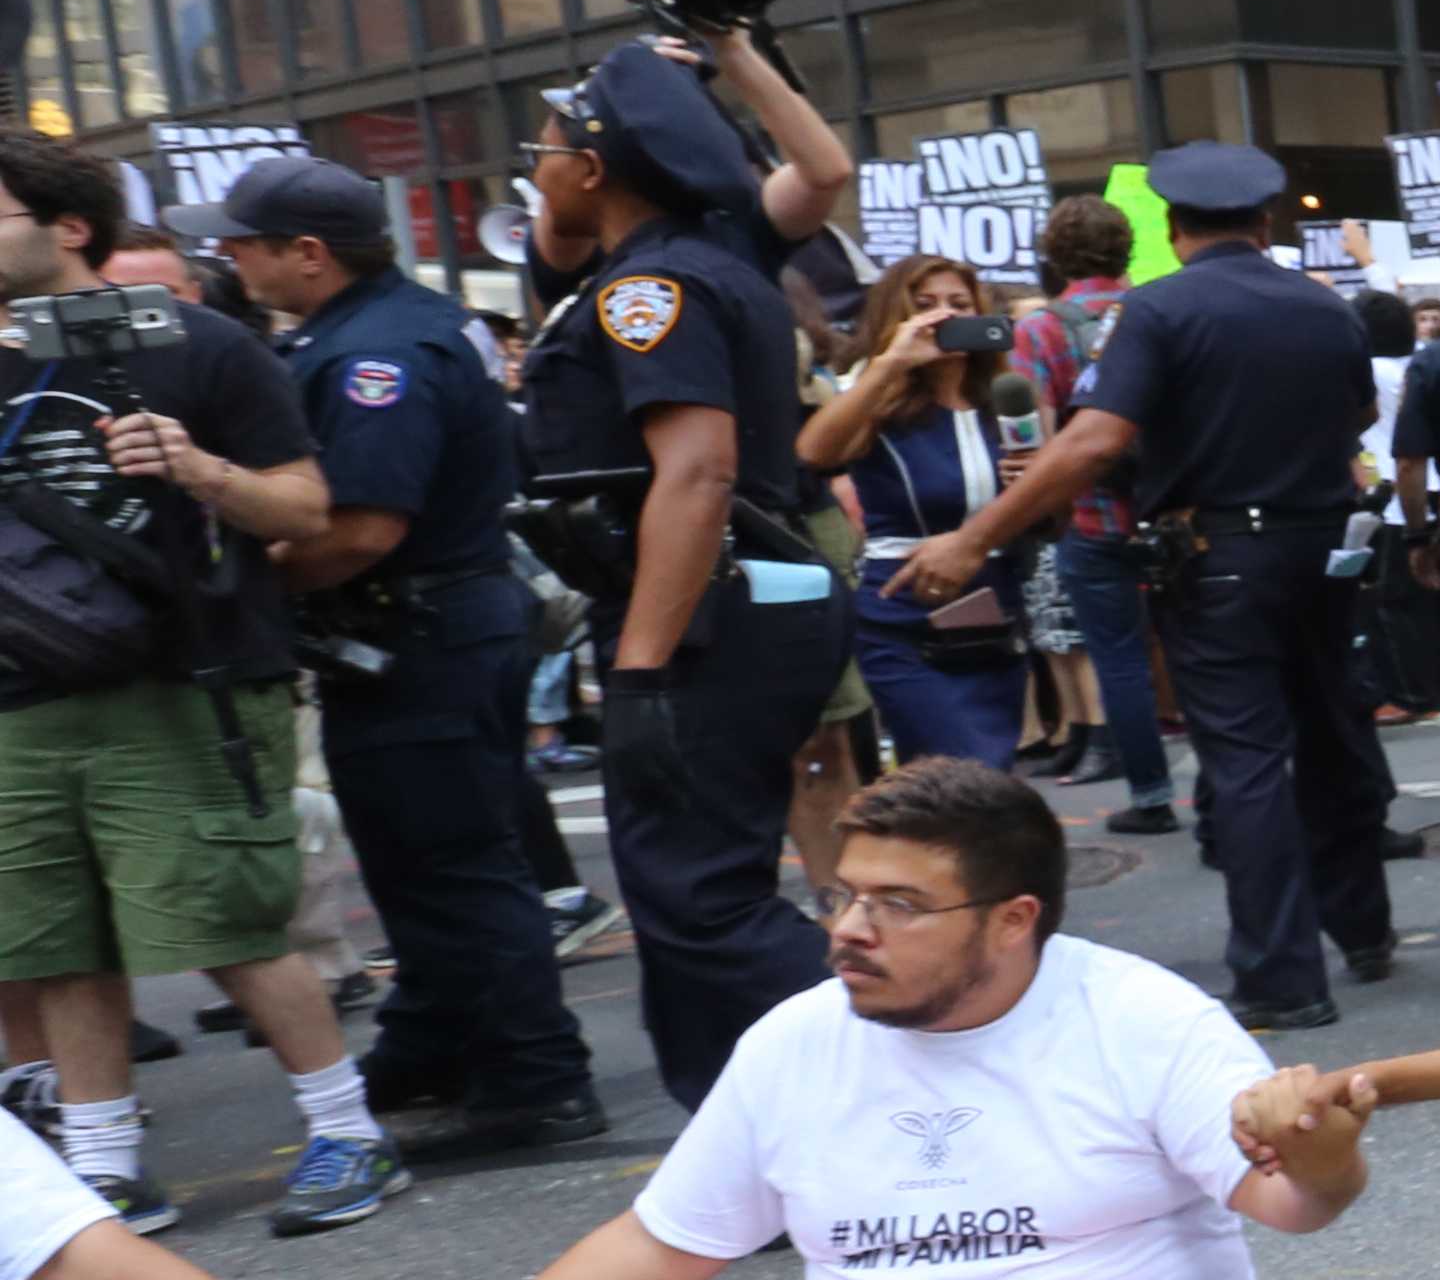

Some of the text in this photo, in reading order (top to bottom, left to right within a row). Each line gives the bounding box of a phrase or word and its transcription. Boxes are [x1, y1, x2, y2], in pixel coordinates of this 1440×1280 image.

[919, 129, 1046, 193] ¡NO!
[918, 204, 1036, 267] NO!
[895, 1176, 968, 1192] COSECHA
[830, 1205, 1040, 1248] #MI LABOR
[889, 1233, 1047, 1269] FAMILIA
